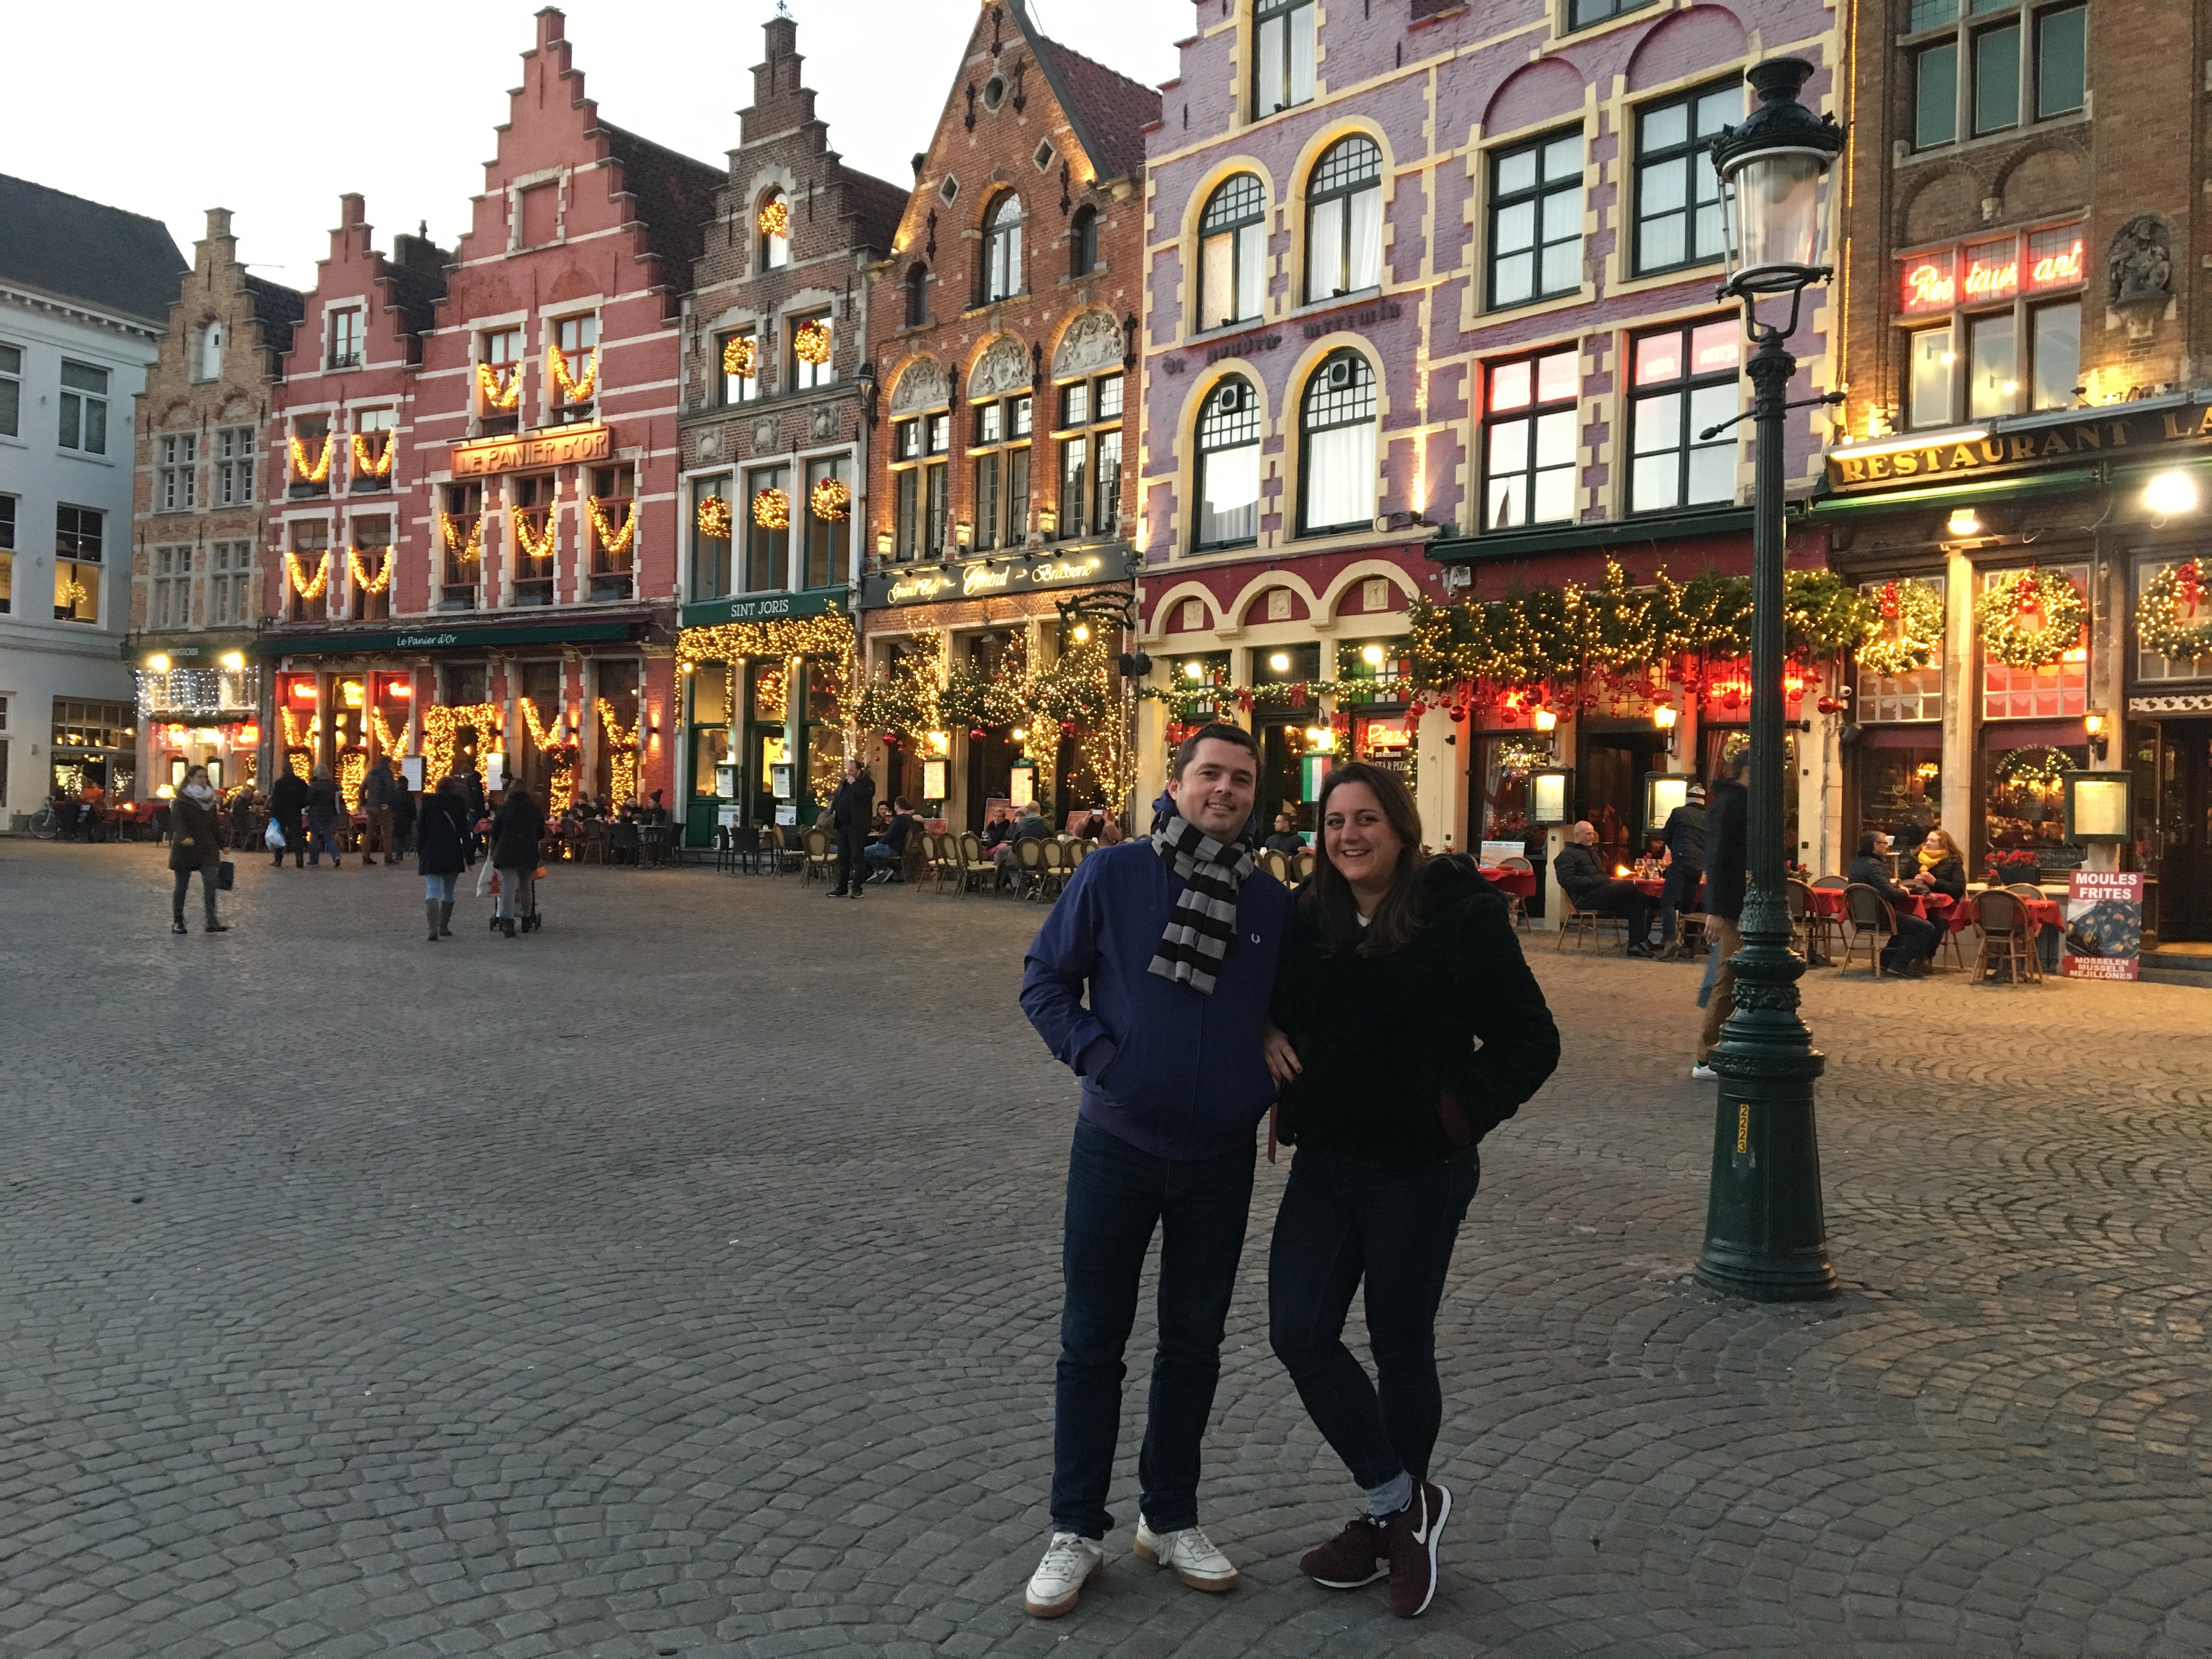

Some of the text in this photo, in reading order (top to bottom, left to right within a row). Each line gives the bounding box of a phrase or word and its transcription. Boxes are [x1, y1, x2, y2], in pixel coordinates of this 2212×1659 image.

[460, 432, 606, 474] LE PANIER D'OR
[1840, 420, 2130, 483] RESTAURANT
[887, 581, 919, 603] Grand
[963, 566, 1010, 595] Central
[1032, 562, 1093, 583] Brasserie
[731, 599, 789, 617] SINT JORIS
[397, 633, 457, 646] Le Panier d'Or
[2076, 873, 2137, 885] MOULES
[2079, 887, 2132, 900] FRITES
[2075, 957, 2129, 966] MOSSELEN
[2069, 970, 2133, 980] MEJILLONES
[2078, 964, 2125, 973] MUSSELS
[1738, 1105, 1748, 1152] 2223
